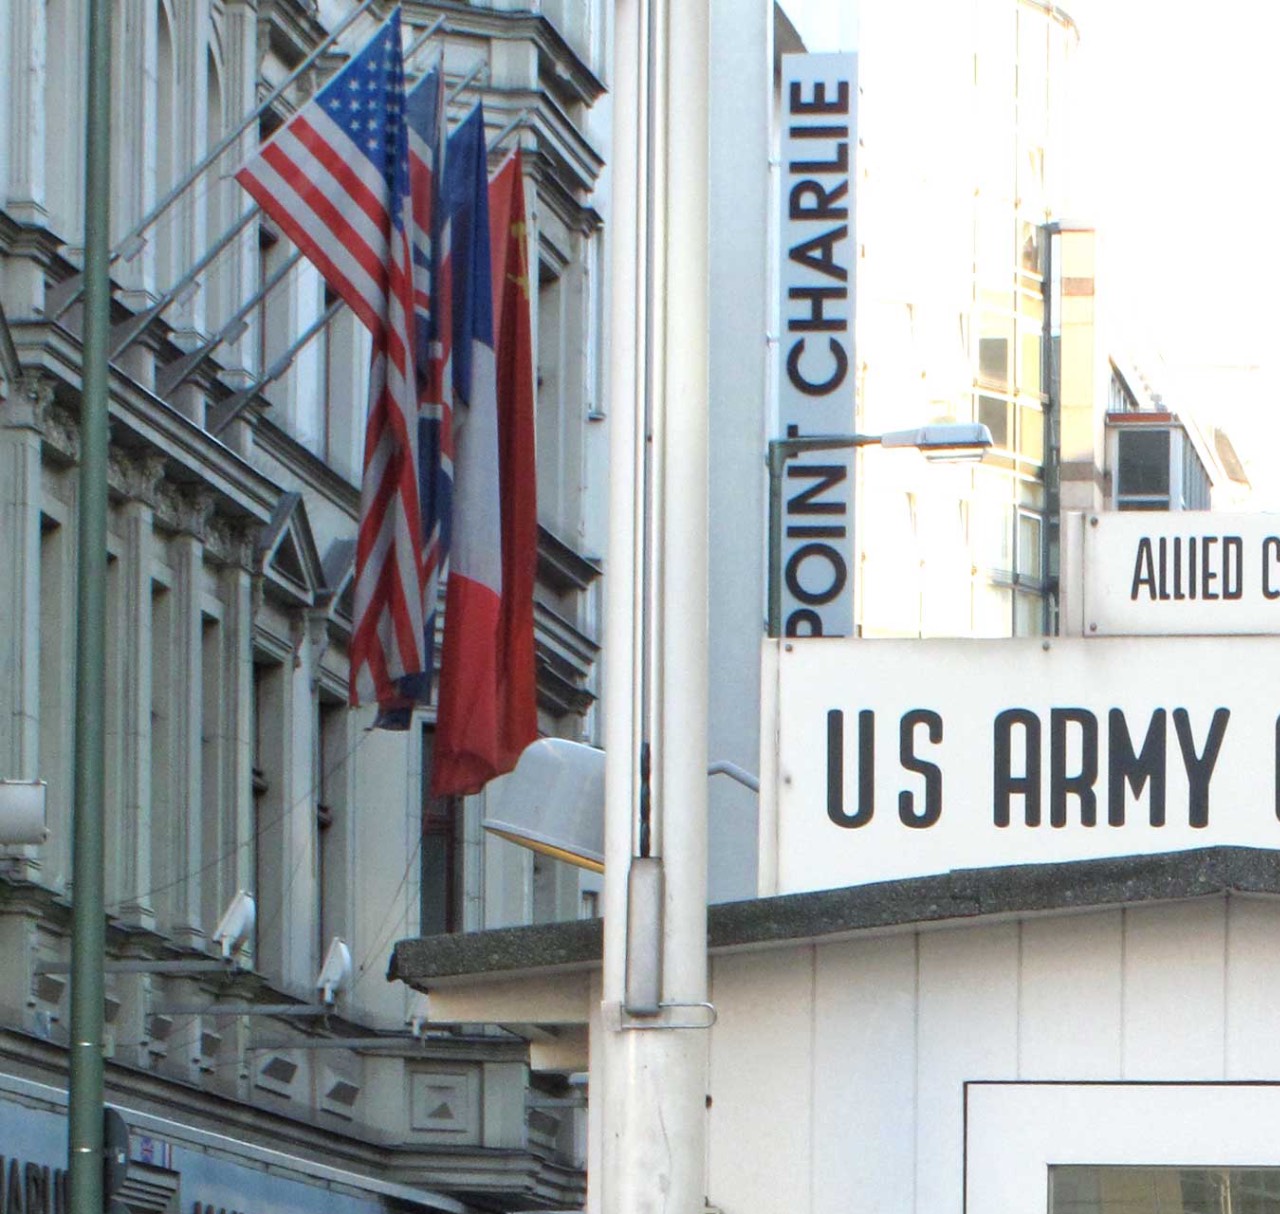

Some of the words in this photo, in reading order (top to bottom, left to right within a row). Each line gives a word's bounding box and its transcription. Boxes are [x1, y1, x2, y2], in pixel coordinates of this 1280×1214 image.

[786, 81, 849, 397] CHARLIE
[784, 424, 848, 639] POIN
[1131, 536, 1243, 601] ALLIED
[827, 708, 944, 829] US
[993, 707, 1232, 829] ARMY
